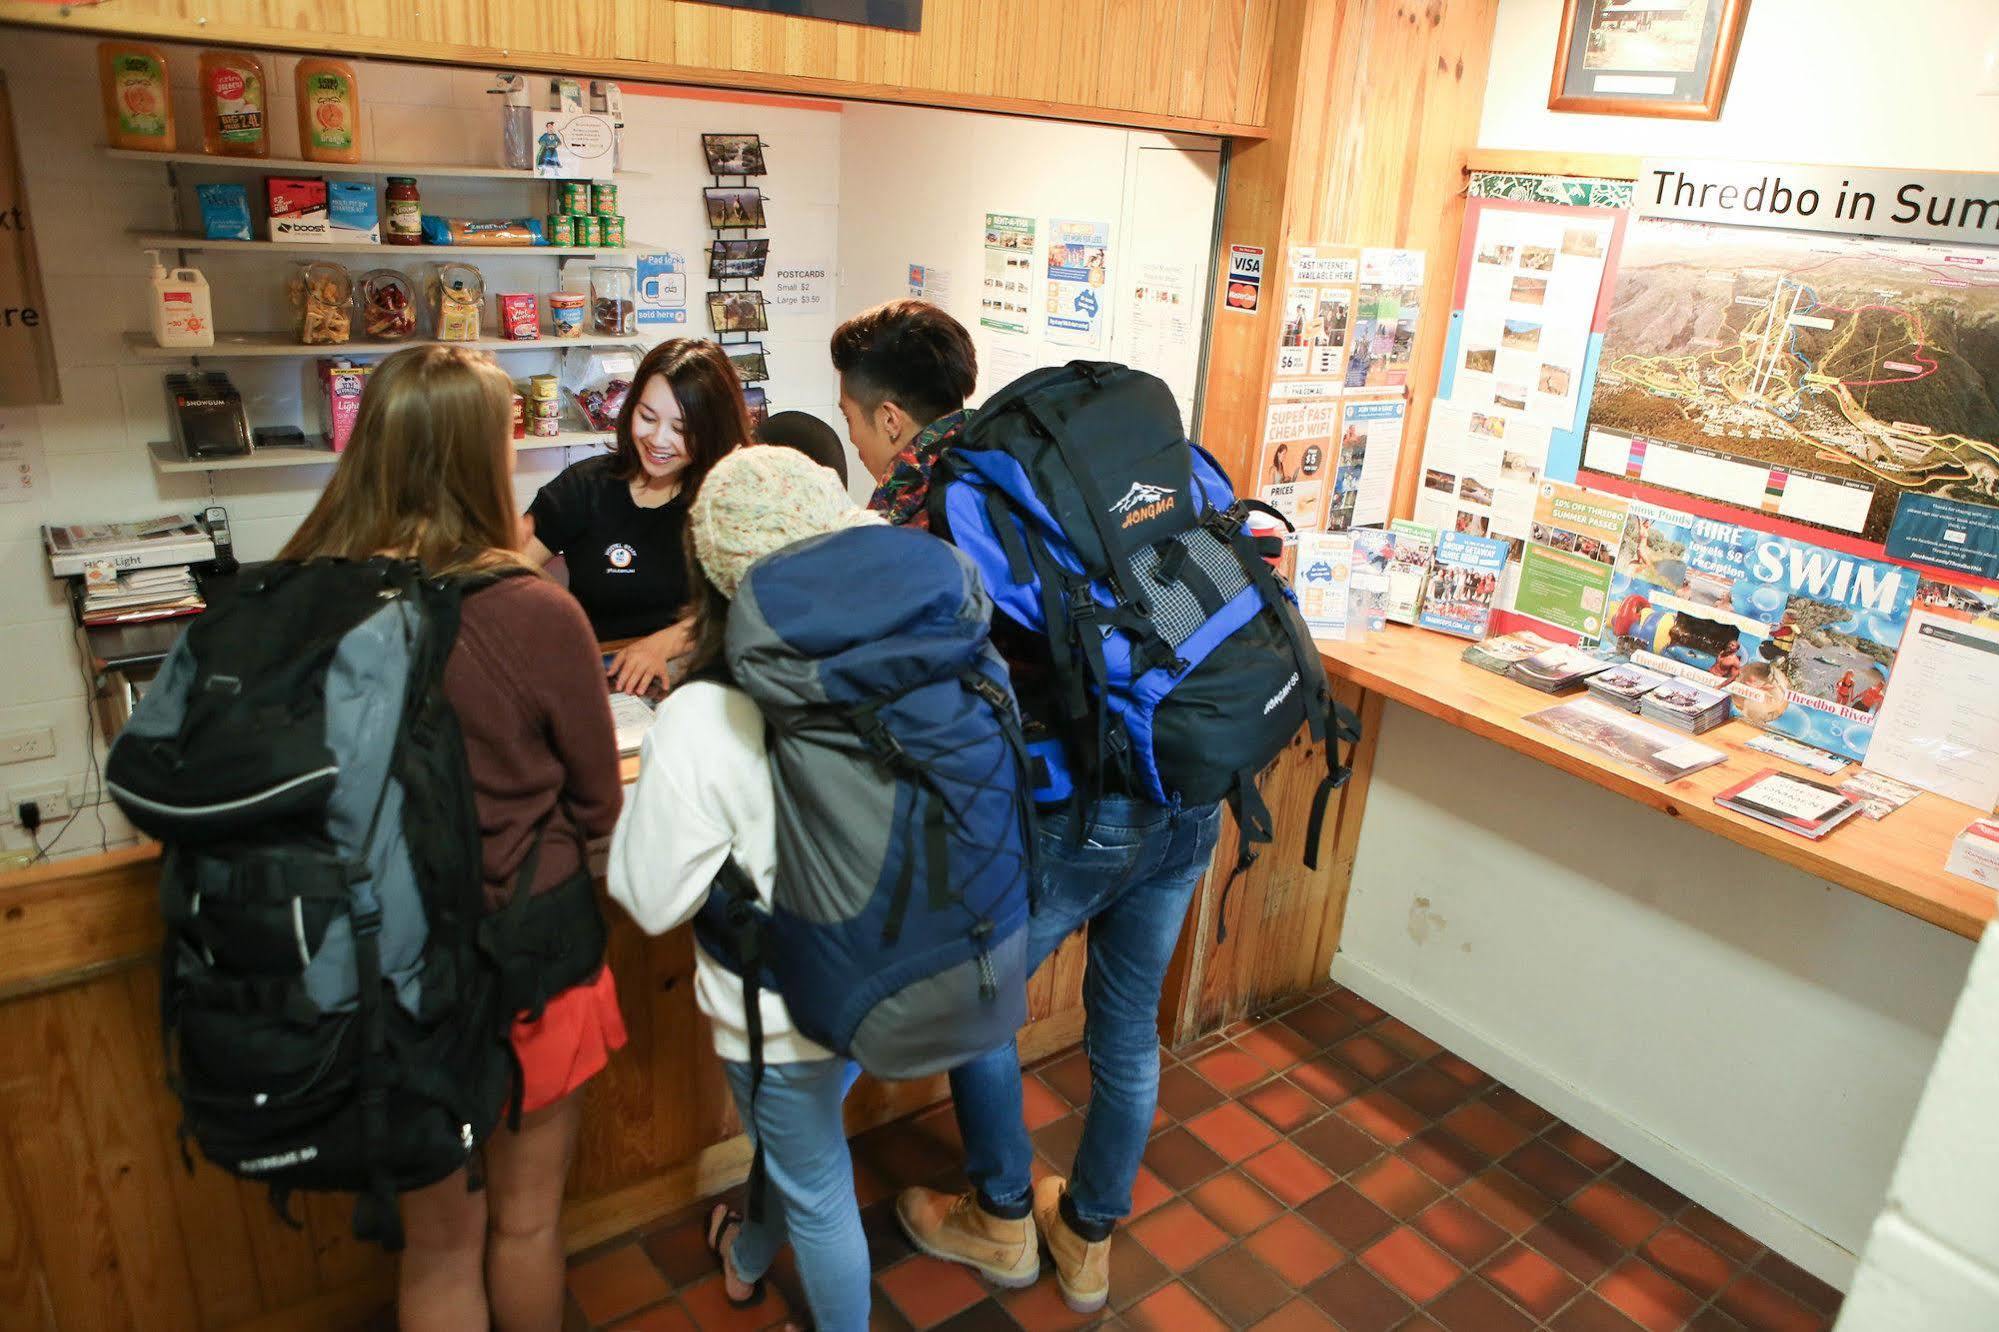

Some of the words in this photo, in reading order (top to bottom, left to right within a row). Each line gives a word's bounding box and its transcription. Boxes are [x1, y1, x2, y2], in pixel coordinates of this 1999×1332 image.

[222, 114, 238, 123] BIG
[1652, 169, 1821, 217] Thredbo
[1834, 180, 1876, 221] in
[293, 222, 326, 233] boost
[648, 255, 664, 264] Pad
[1234, 257, 1260, 273] VISA
[1299, 261, 1316, 270] FAST
[1317, 261, 1349, 270] INTERNET
[776, 270, 825, 279] POSTCARDS
[1298, 270, 1334, 280] AVAILABLE
[1335, 271, 1354, 280] HERE
[776, 283, 798, 292] Small
[801, 283, 810, 291] $2
[776, 296, 798, 305] Large
[638, 311, 656, 319] sold
[658, 310, 675, 319] here
[1281, 355, 1294, 368] $6
[1270, 411, 1304, 426] SUPER
[1307, 407, 1333, 422] FAST
[1269, 425, 1305, 440] CHEAP
[1305, 455, 1318, 466] $5
[1270, 486, 1294, 497] PRICES
[1554, 498, 1570, 510] 10%
[1571, 502, 1587, 513] OFF
[1587, 506, 1625, 522] THREDBO
[1552, 510, 1588, 524] SUMMER
[1588, 516, 1619, 530] PASSES
[1657, 507, 1693, 527] Ponds
[1695, 521, 1744, 547] HIRE
[115, 555, 142, 568] Light
[1751, 540, 1902, 615] SWIM
[1785, 688, 1838, 716] Thredbo
[1838, 704, 1876, 726] River
